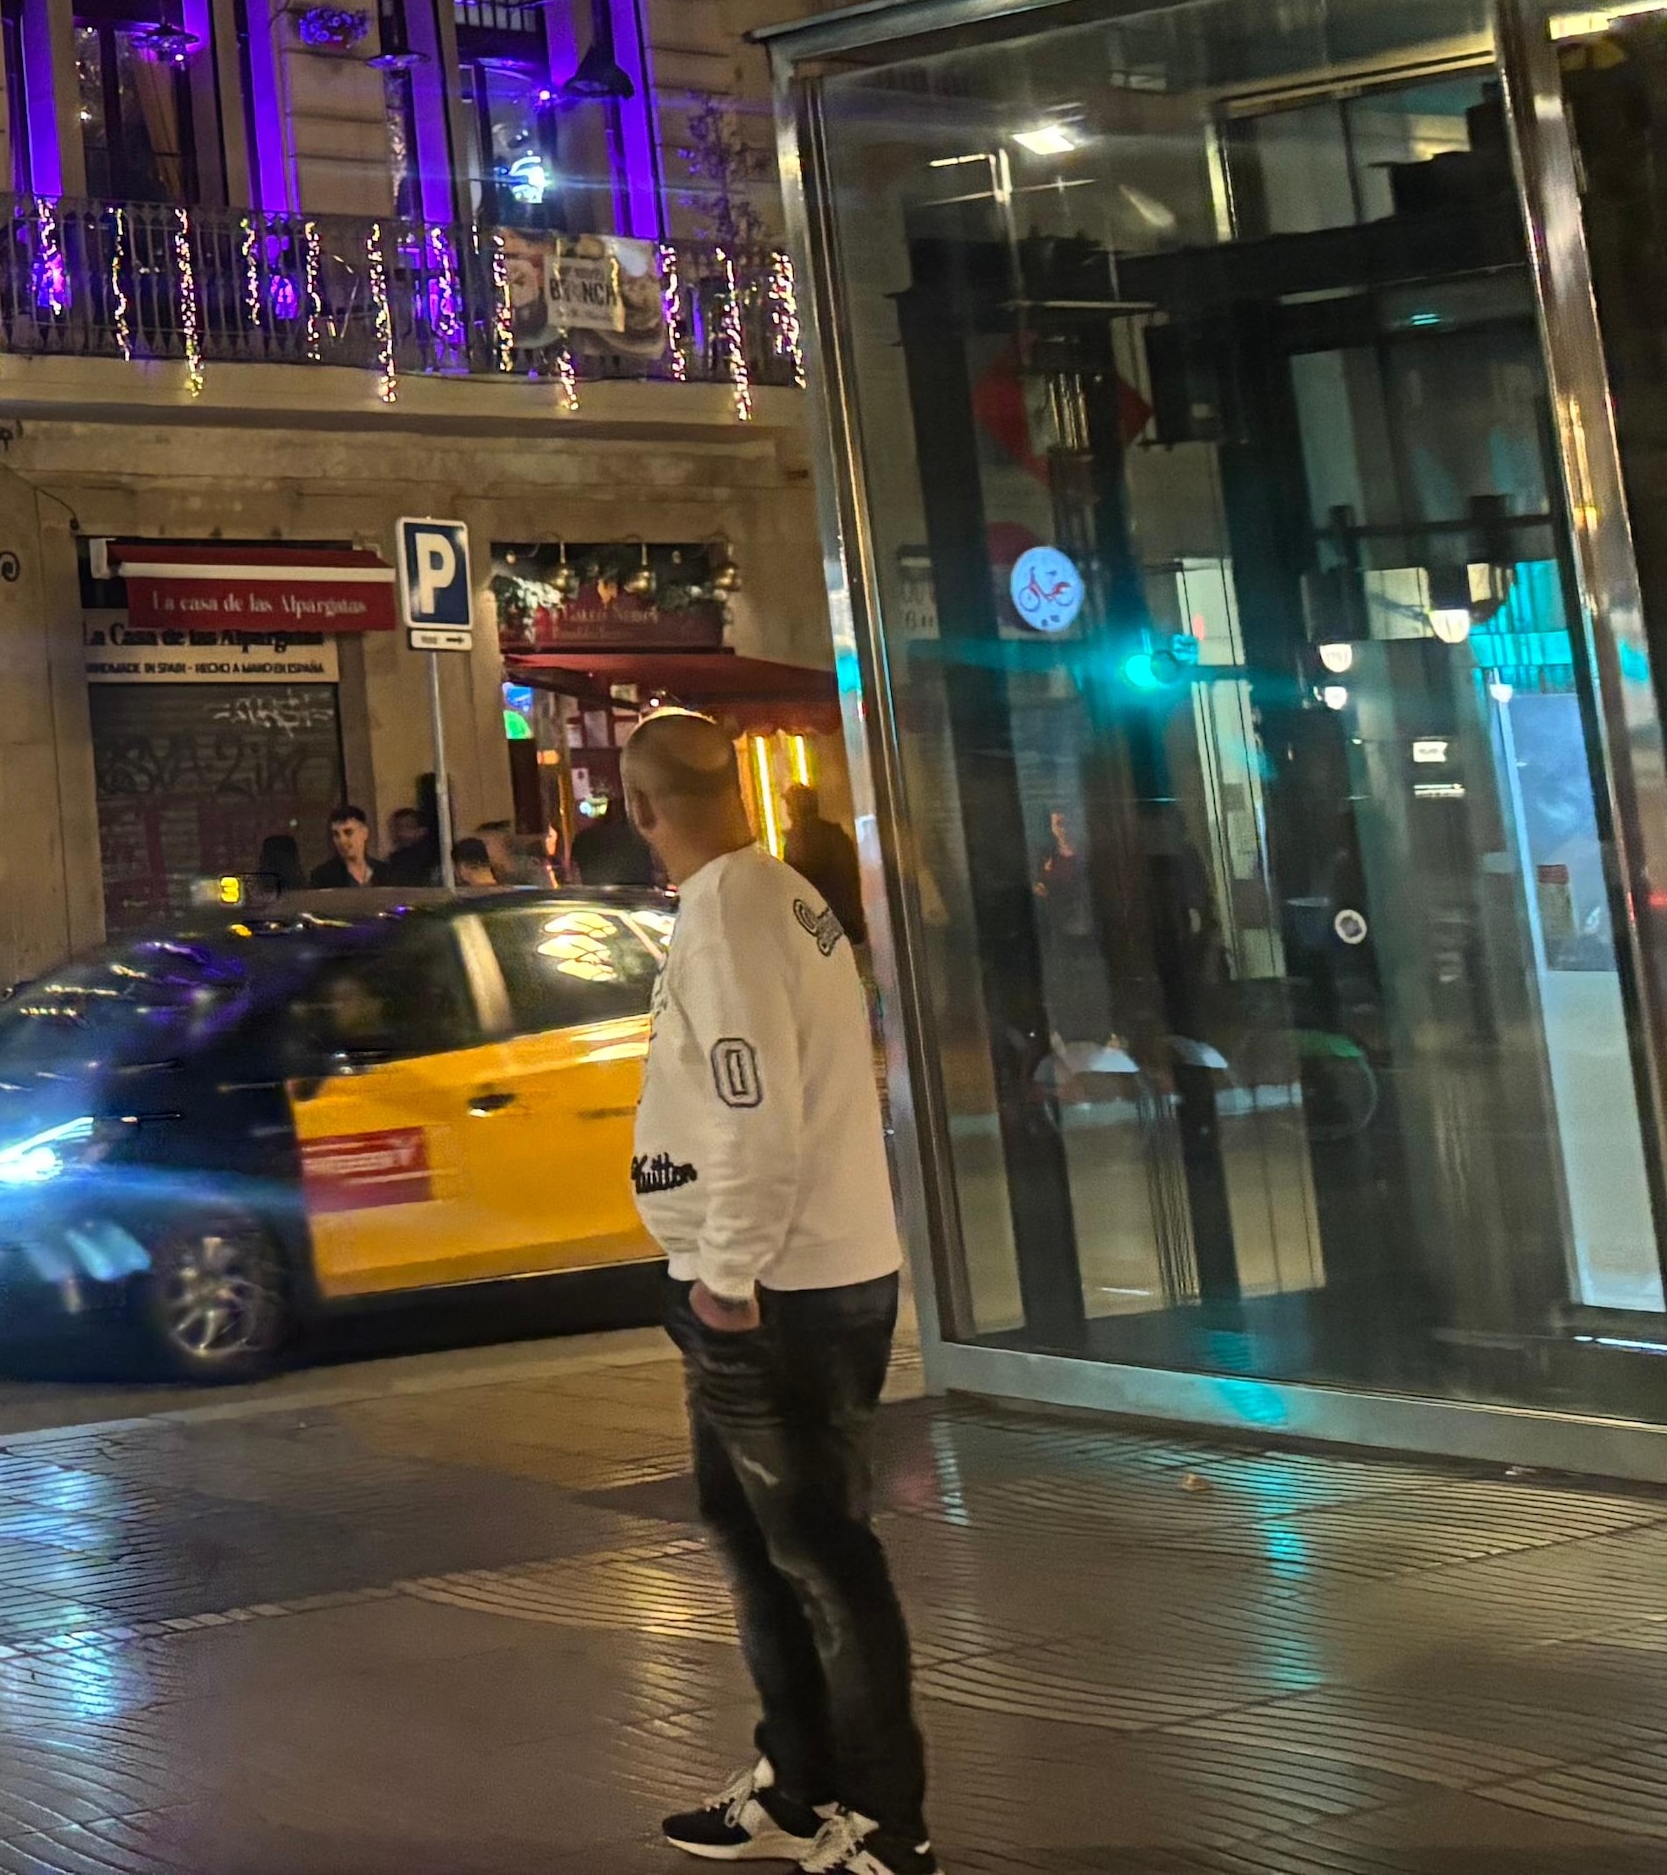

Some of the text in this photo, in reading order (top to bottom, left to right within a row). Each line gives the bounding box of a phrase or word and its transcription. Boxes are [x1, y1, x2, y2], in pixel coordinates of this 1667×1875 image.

[415, 532, 456, 614] P
[153, 591, 366, 620] La casa de las Alpargatas
